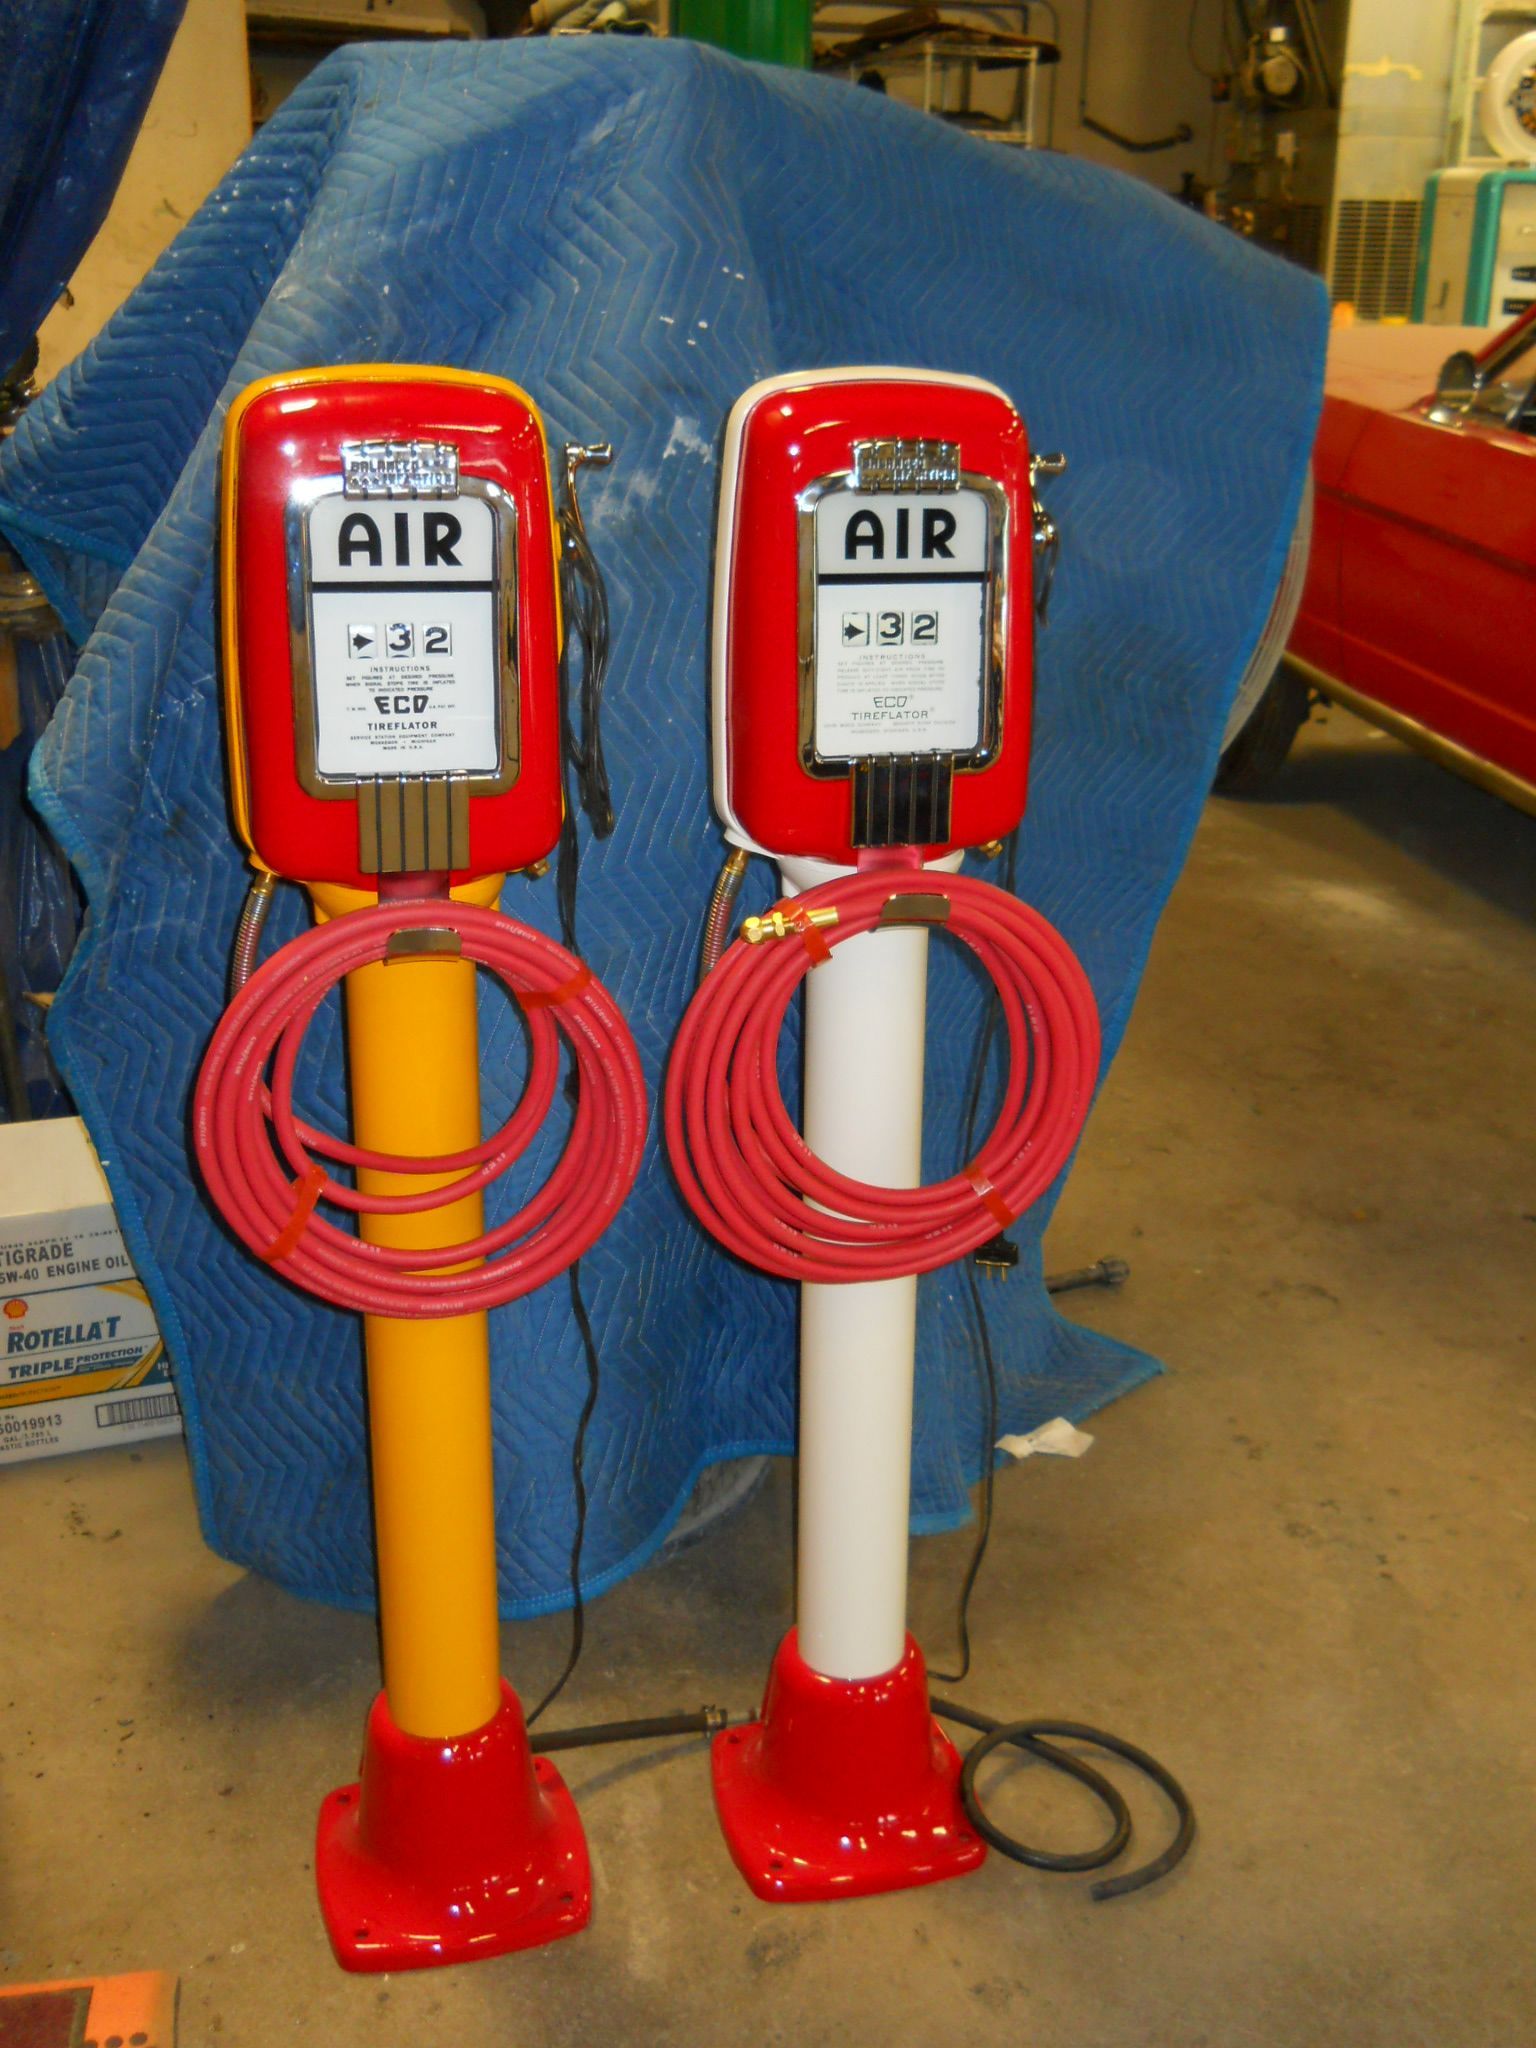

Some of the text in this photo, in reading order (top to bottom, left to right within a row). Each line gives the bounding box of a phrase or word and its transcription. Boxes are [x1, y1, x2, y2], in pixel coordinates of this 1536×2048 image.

[338, 512, 463, 566] AIR
[845, 508, 957, 560] AIR
[370, 665, 430, 673] INSTRUCTIONS
[374, 694, 429, 715] ECO
[873, 695, 908, 708] ECO
[367, 721, 438, 731] TIREFLATOR
[851, 710, 929, 721] TIREFLATOR
[47, 1259, 101, 1278] ENGINE
[105, 1255, 129, 1269] OIL
[7, 1316, 121, 1354] ROTELLA T
[8, 1346, 143, 1379] TRIPLE PROTECTION
[25, 1436, 60, 1447] BOTTLES
